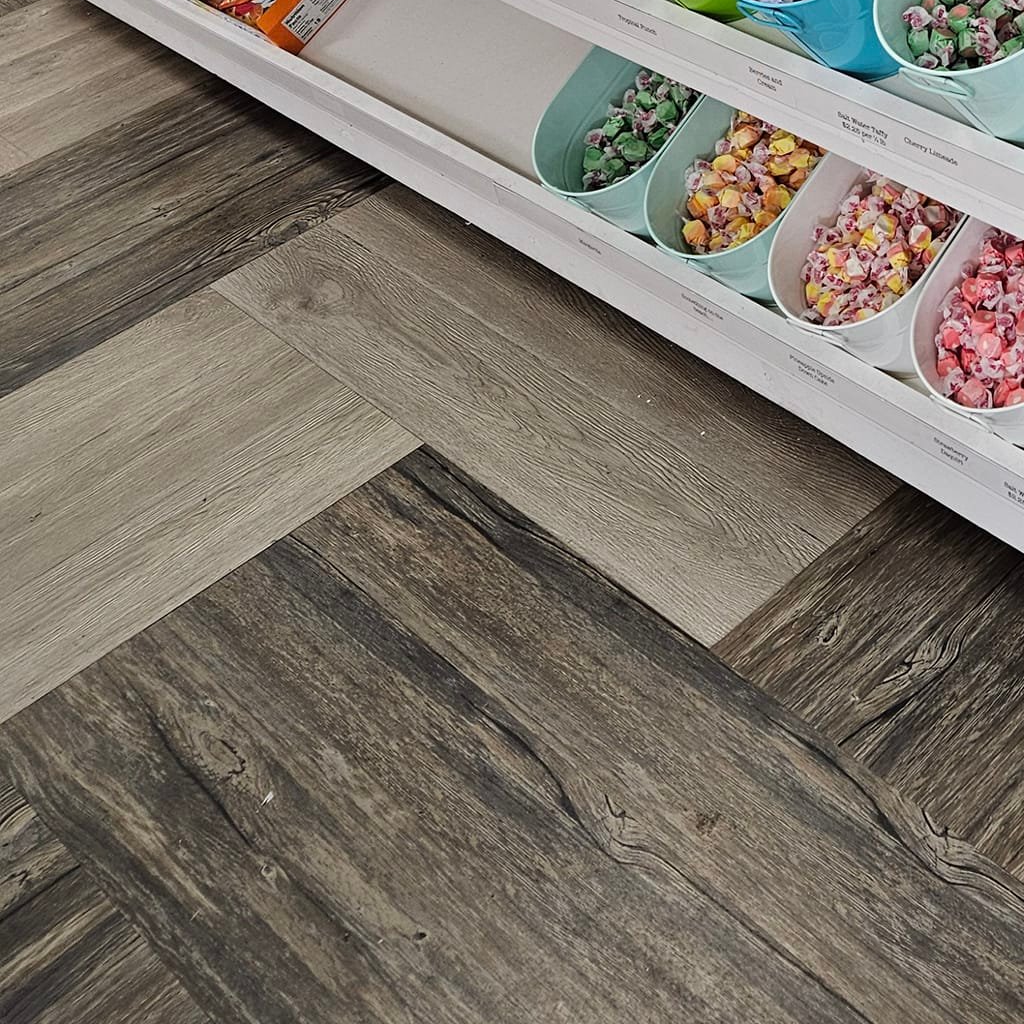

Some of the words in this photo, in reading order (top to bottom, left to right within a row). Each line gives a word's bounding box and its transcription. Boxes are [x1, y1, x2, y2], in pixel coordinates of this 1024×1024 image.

[871, 125, 889, 139] Taffy
[903, 137, 928, 153] Cherry
[929, 148, 959, 166] Limeade
